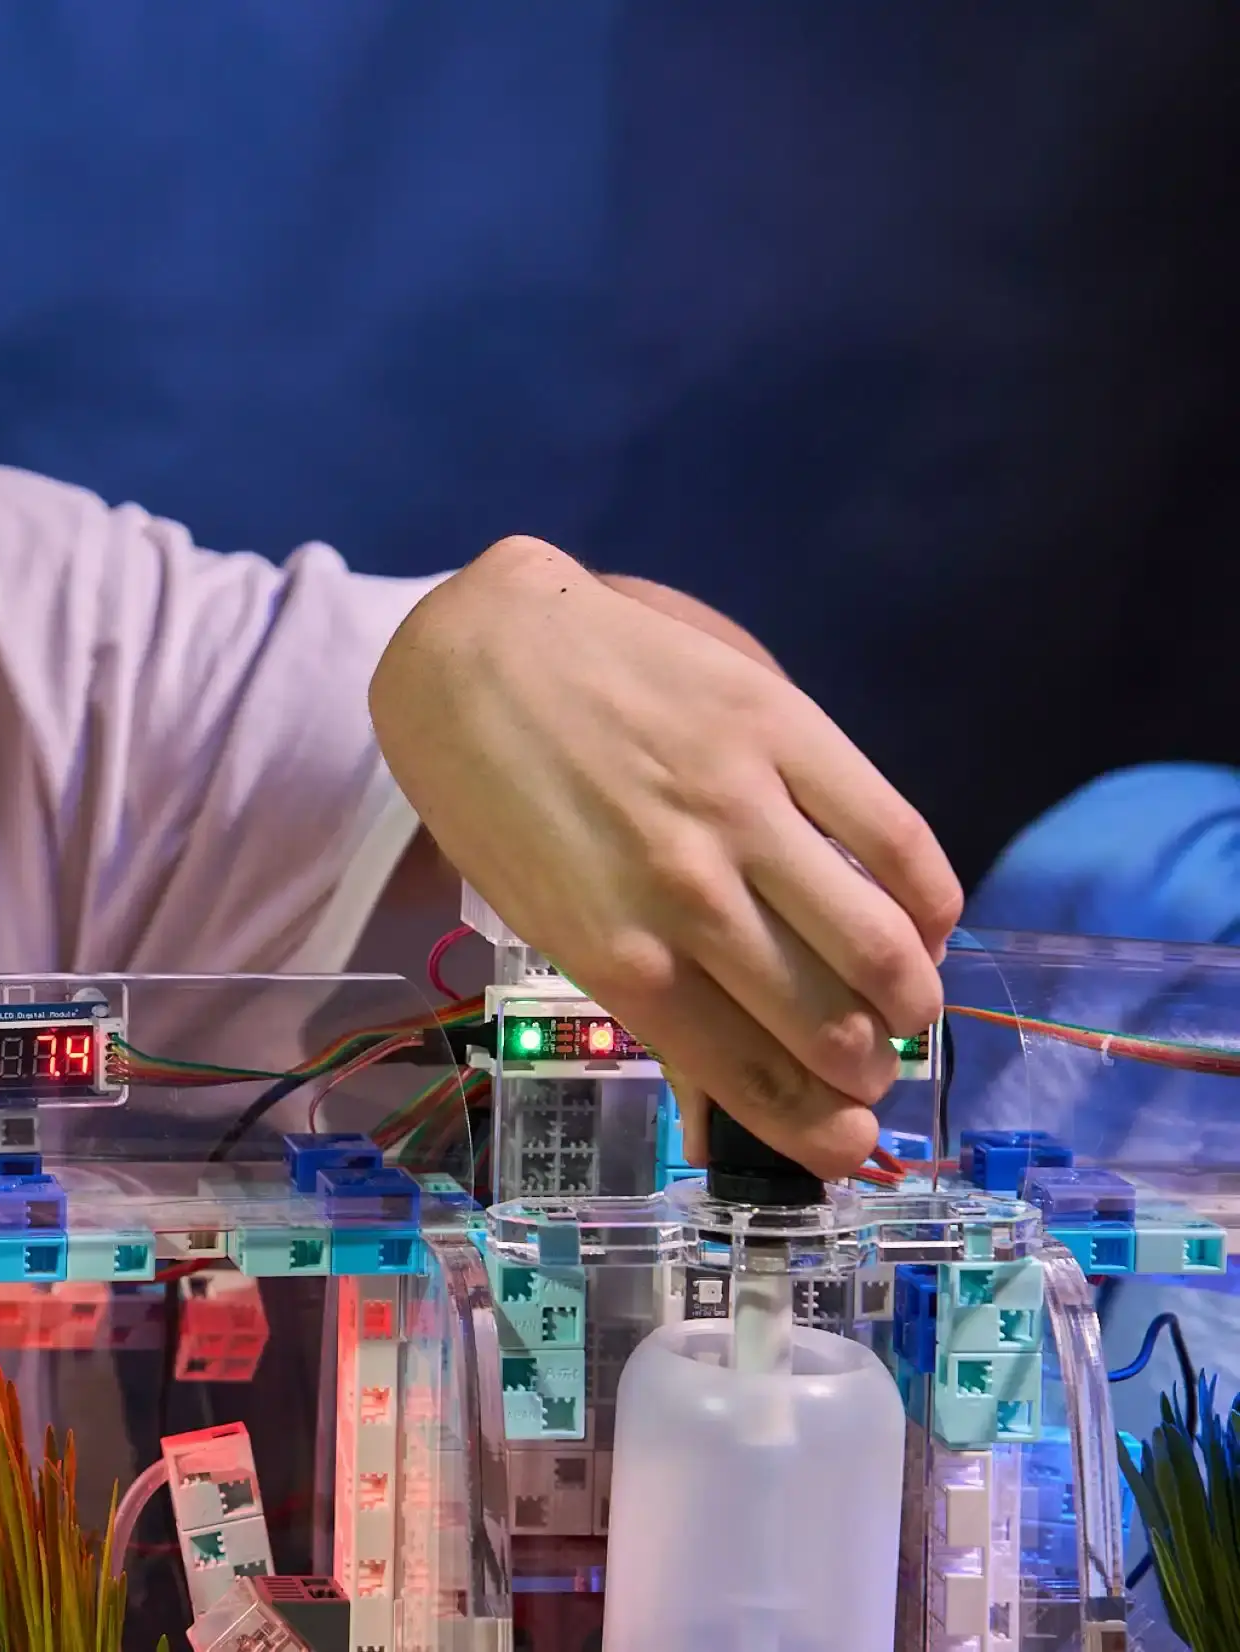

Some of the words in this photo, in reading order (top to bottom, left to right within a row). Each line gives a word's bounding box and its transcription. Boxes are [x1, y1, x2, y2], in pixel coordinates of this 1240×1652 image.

[0, 1011, 15, 1020] LED
[17, 1011, 46, 1020] Digital
[49, 1009, 78, 1018] Module
